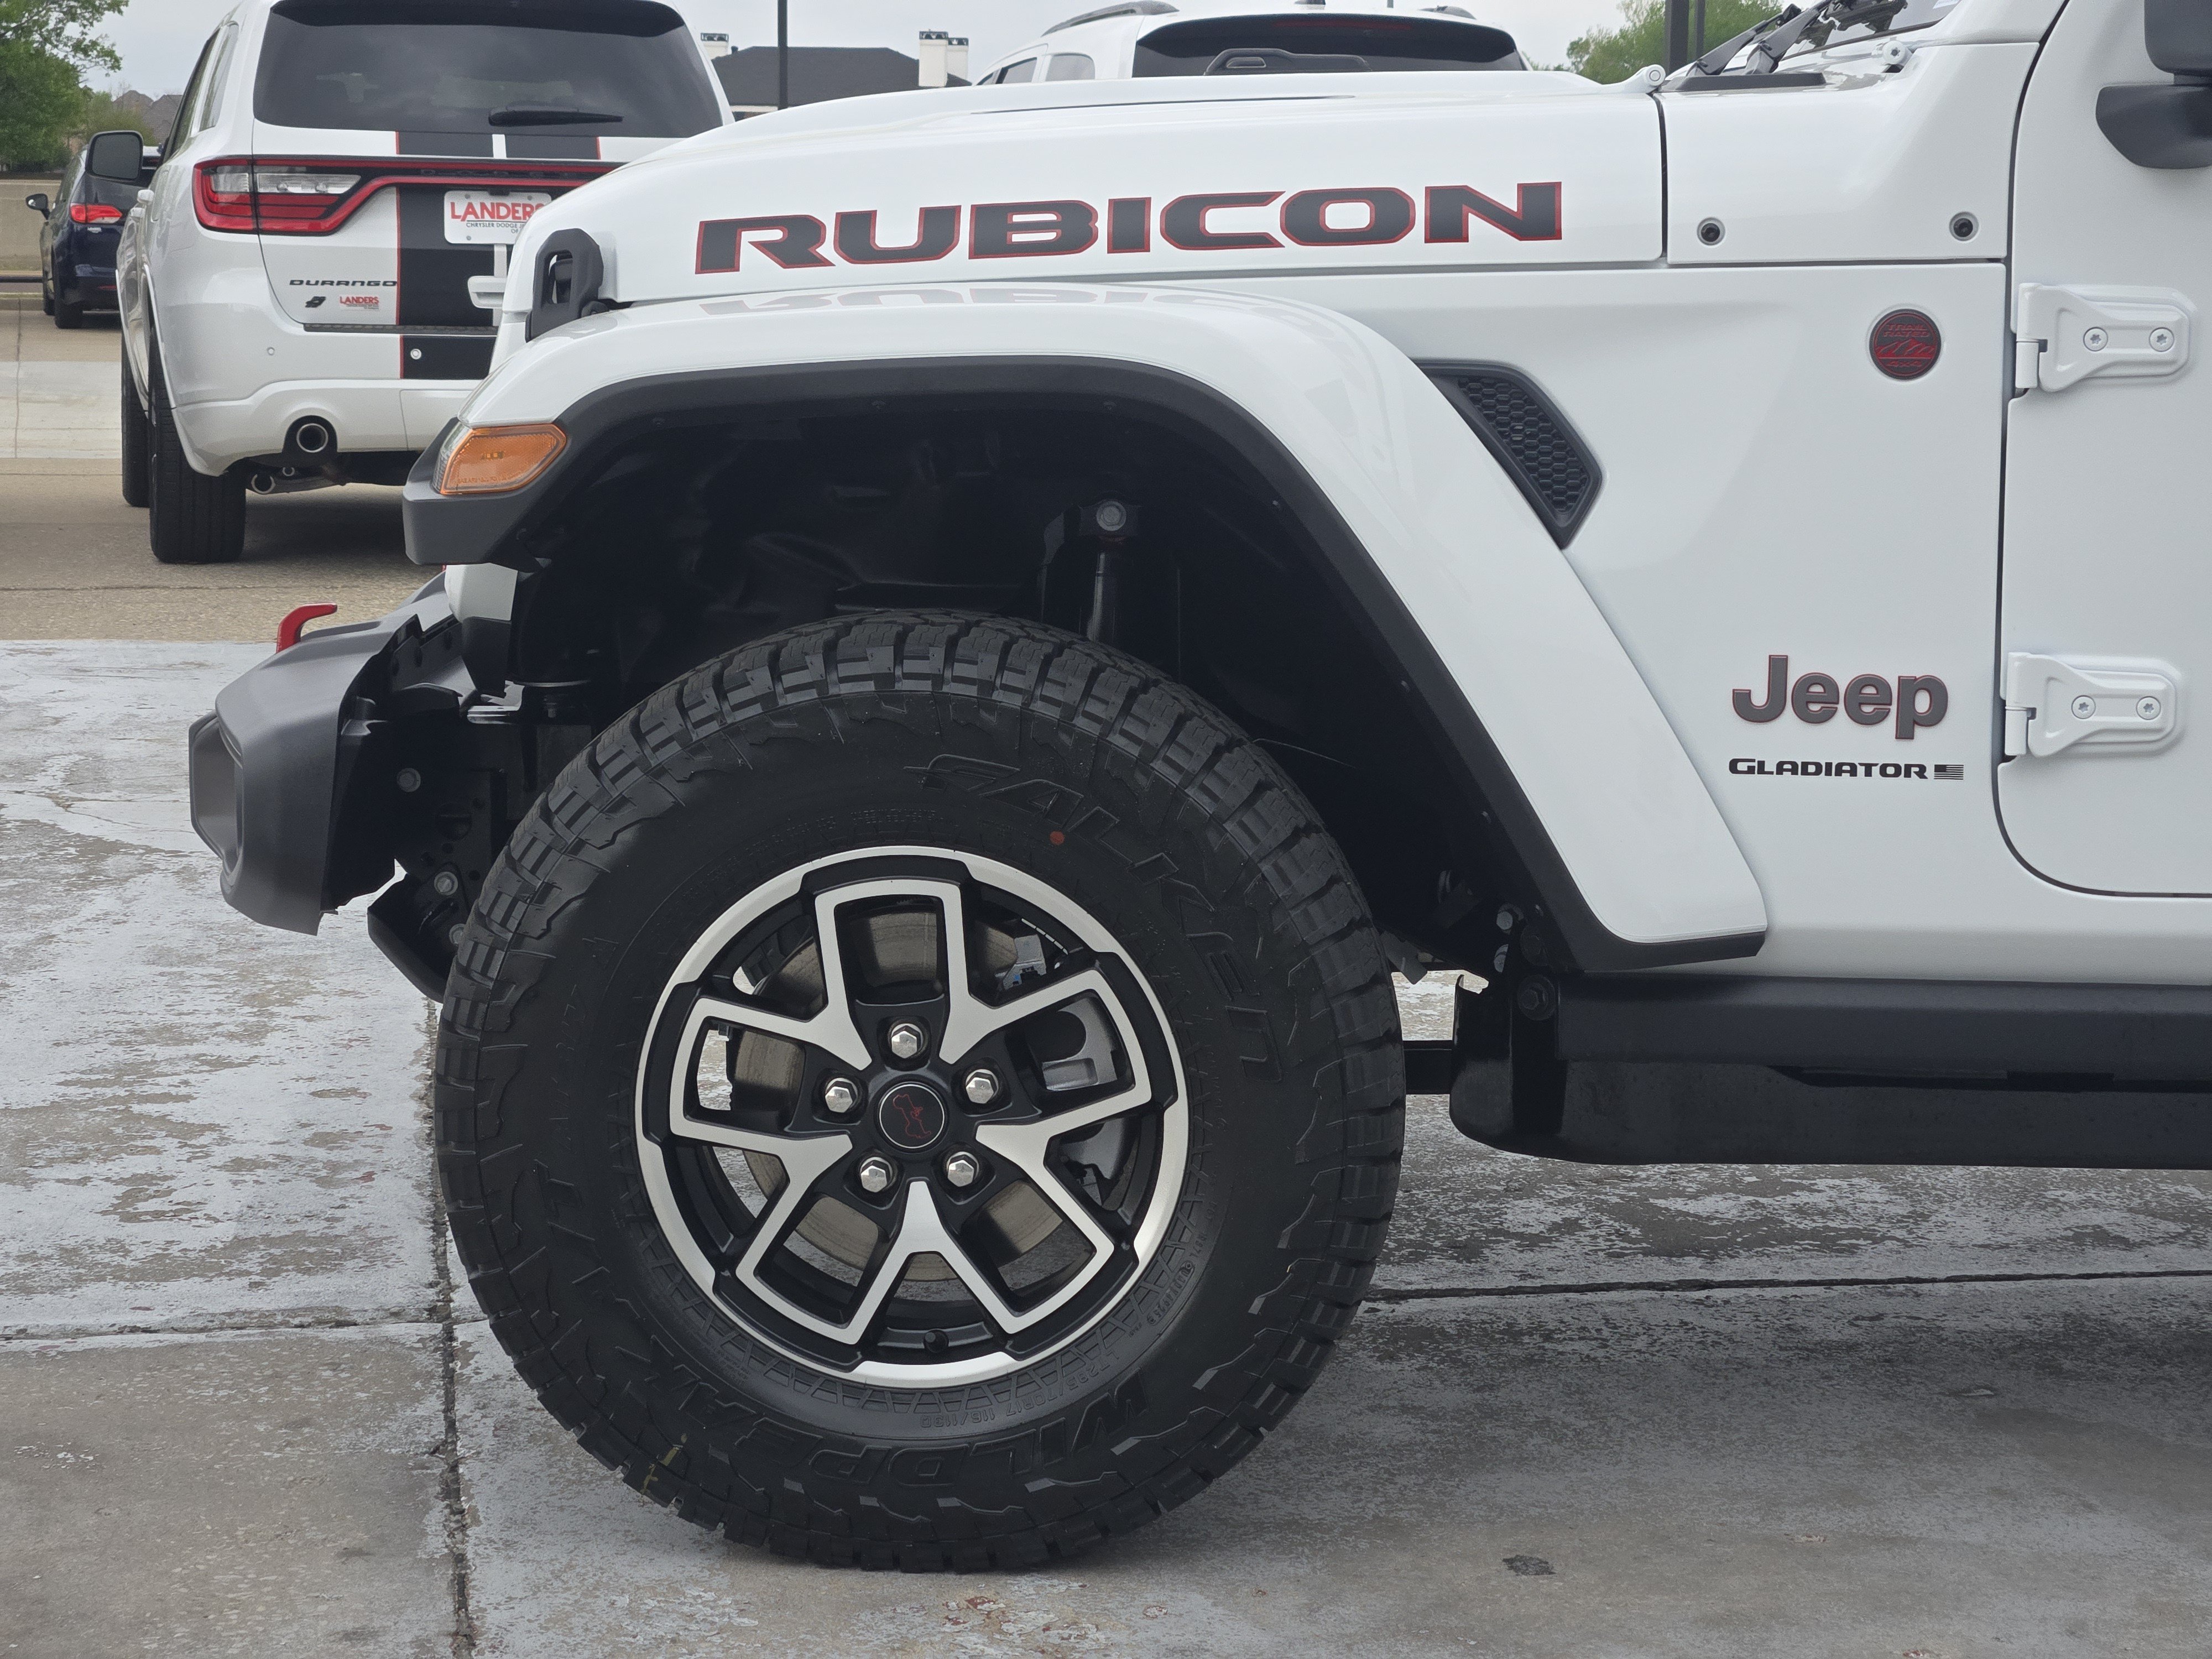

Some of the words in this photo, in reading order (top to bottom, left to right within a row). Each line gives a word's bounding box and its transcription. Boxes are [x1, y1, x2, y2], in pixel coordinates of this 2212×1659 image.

[695, 181, 1562, 274] RUBICON
[1732, 654, 1948, 740] Jeep
[1729, 758, 1928, 779] GLADIATOR
[614, 1334, 1149, 1488] WILDPEAK
